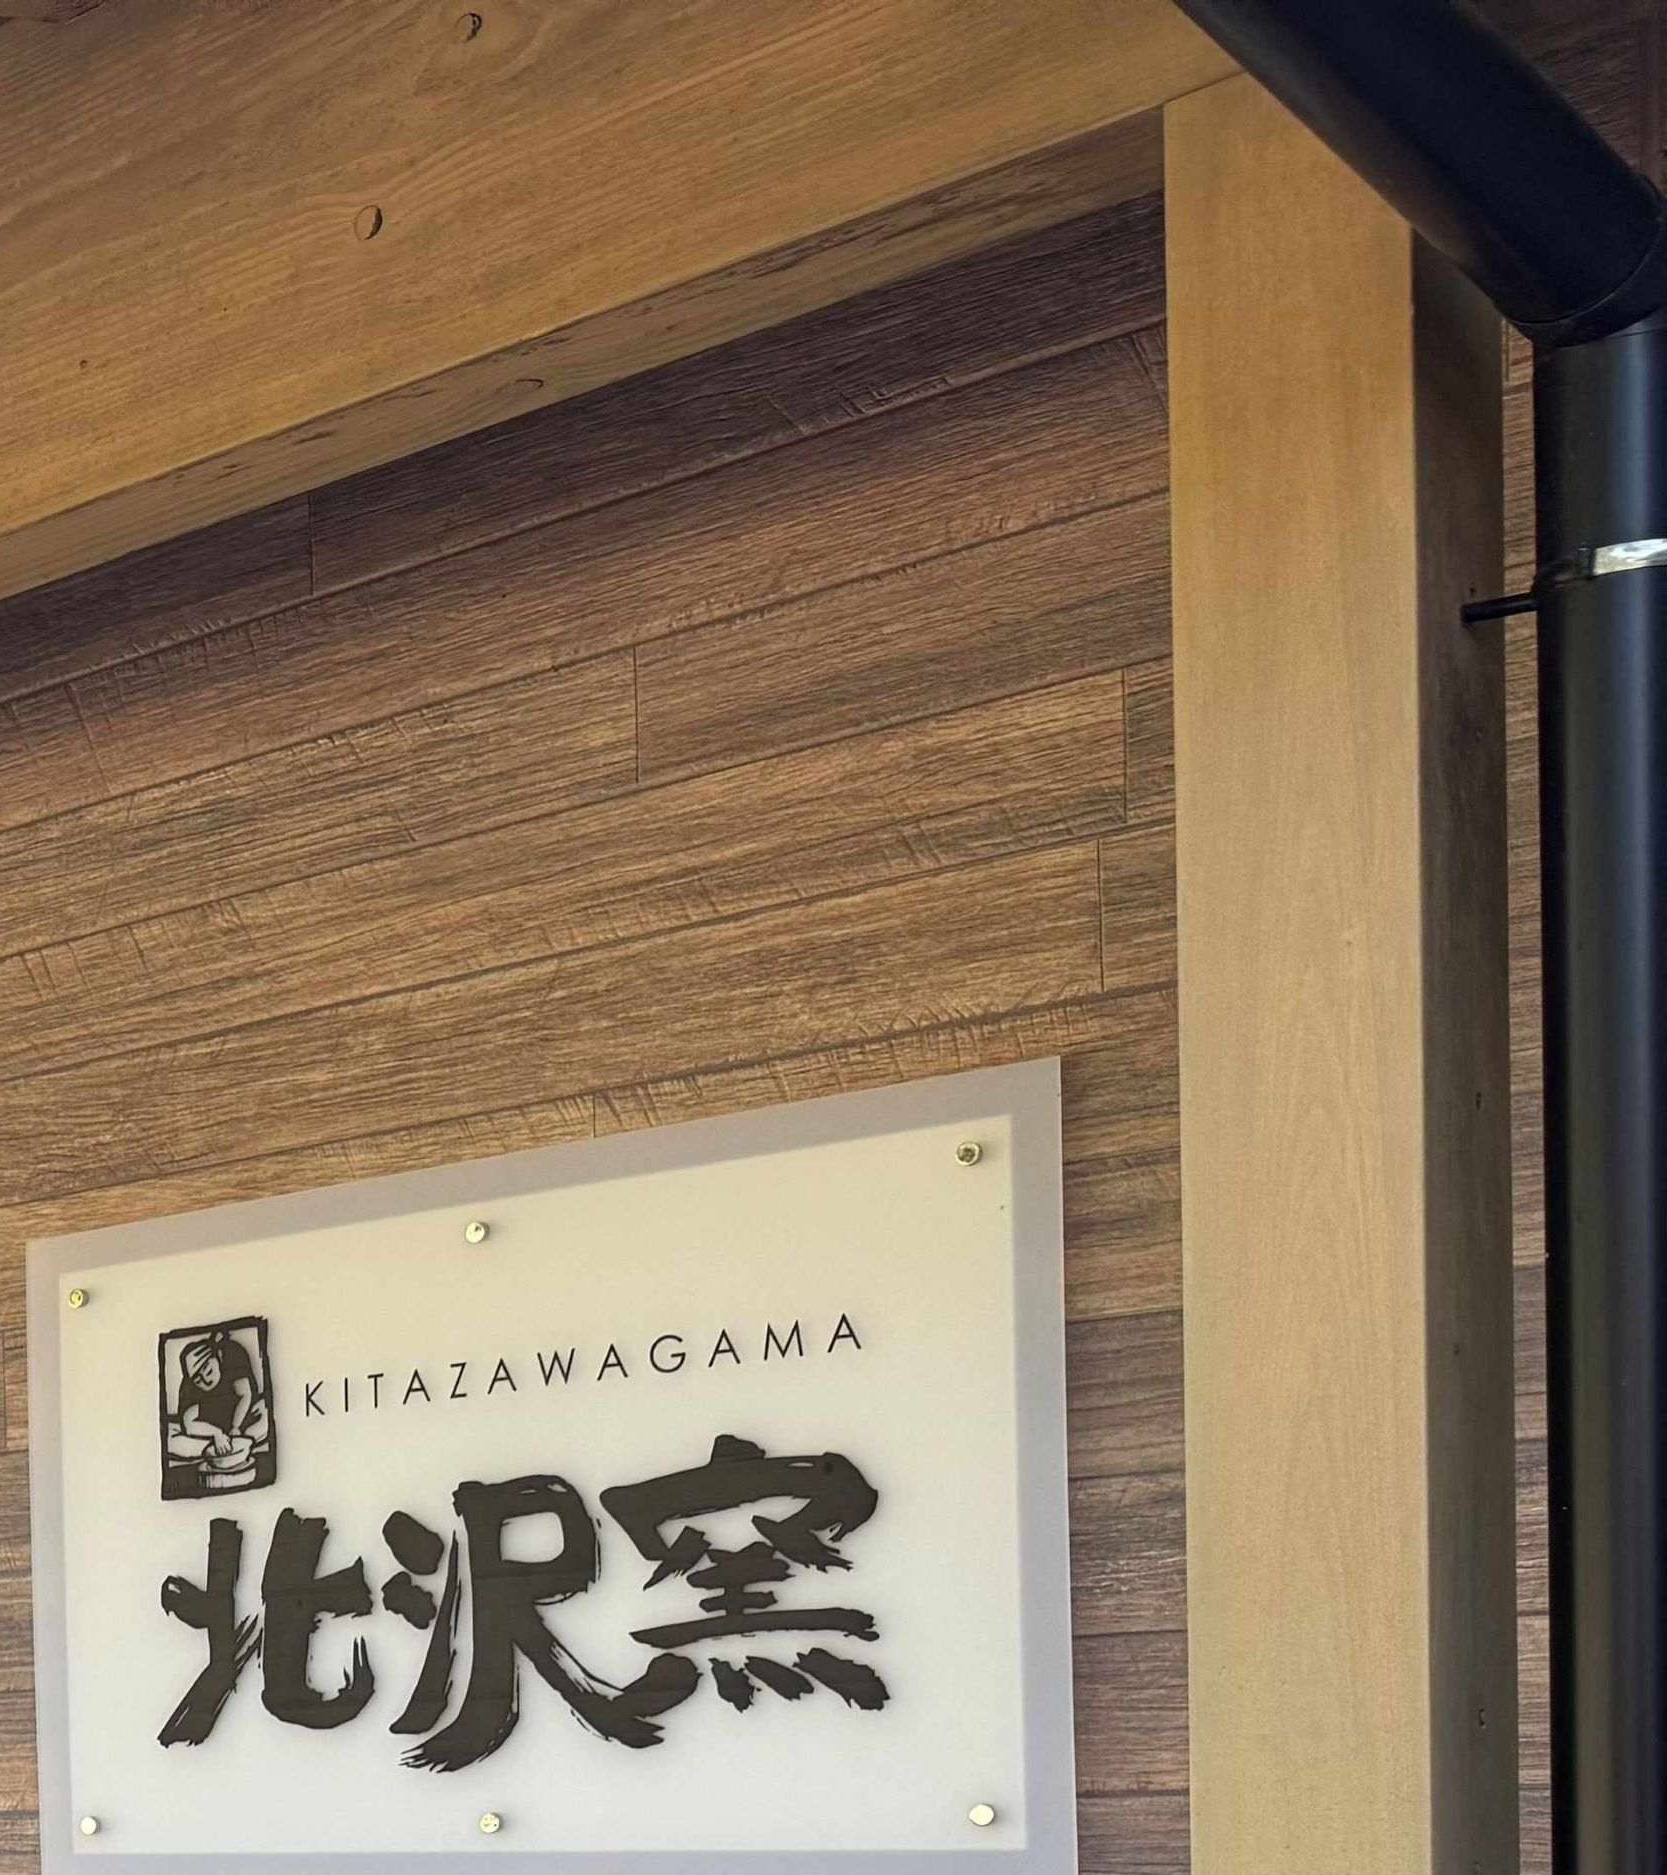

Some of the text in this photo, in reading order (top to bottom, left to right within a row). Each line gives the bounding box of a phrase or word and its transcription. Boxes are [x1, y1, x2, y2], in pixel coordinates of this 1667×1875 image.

[304, 1313, 863, 1417] KITAZAWAGAMA
[157, 1434, 891, 1773] 北沢窯
